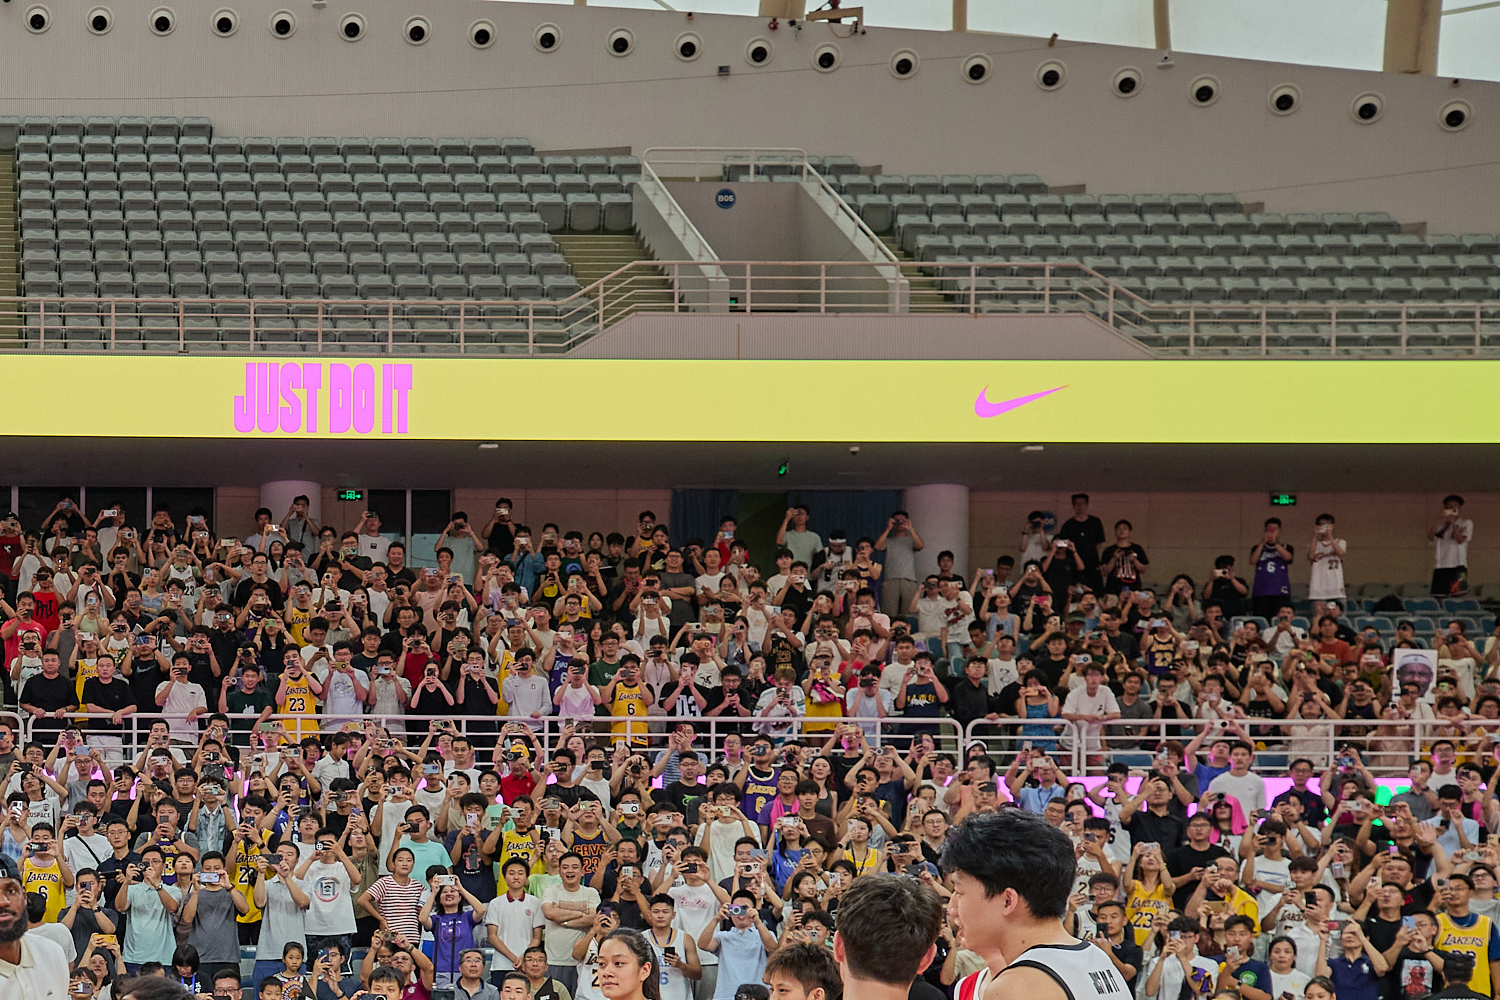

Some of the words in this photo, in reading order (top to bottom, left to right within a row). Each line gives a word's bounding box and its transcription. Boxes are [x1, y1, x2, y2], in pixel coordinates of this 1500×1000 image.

[233, 362, 322, 433] JUST
[329, 363, 375, 434] DO
[382, 363, 413, 434] IT
[289, 697, 306, 713] 23
[627, 703, 635, 715] 6
[747, 783, 777, 796] LAKERS
[756, 796, 766, 814] 6
[26, 871, 60, 885] LAKERS
[1134, 912, 1154, 930] 23
[1450, 934, 1490, 948] LAKERS
